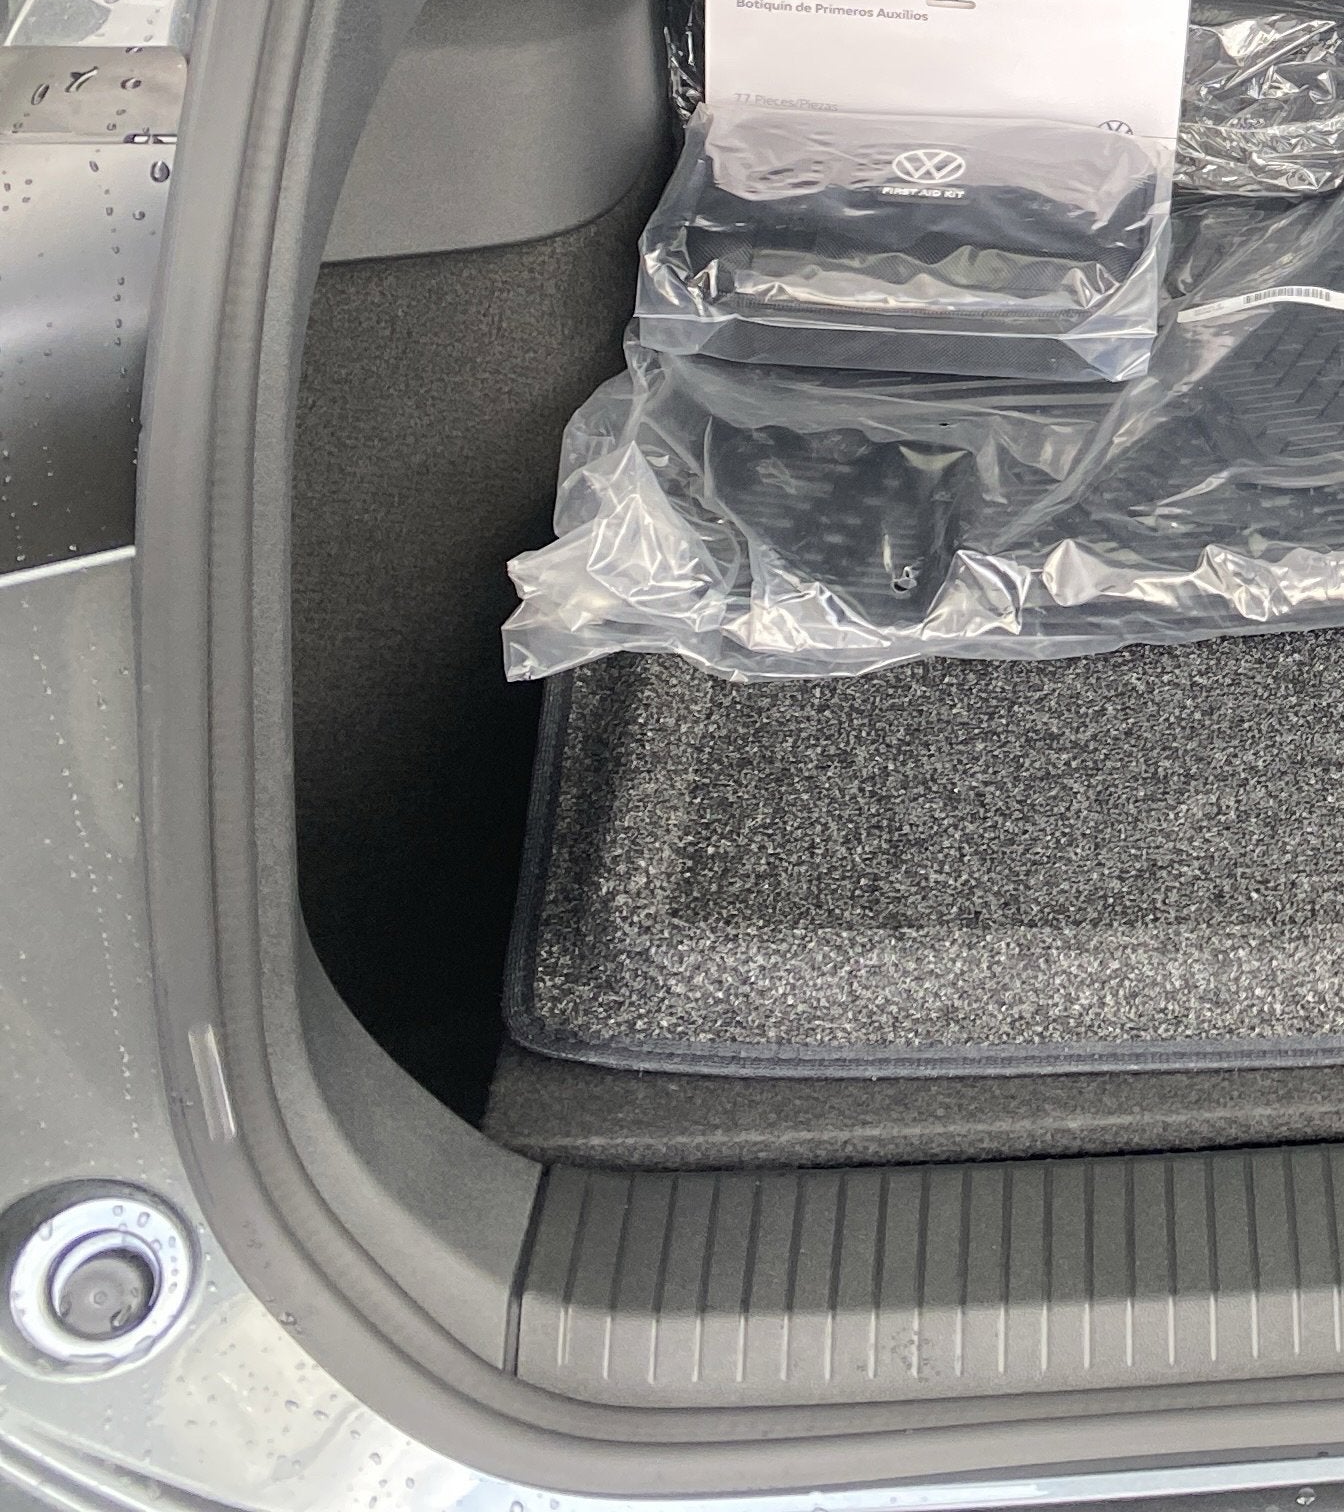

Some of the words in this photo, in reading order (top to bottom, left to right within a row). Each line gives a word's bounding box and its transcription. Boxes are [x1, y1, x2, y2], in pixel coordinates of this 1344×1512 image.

[795, 1, 812, 13] de
[815, 3, 874, 18] Primeros
[876, 7, 929, 22] Auxilios
[733, 92, 751, 104] 77
[754, 94, 839, 112] Pieces/Piezas
[881, 186, 918, 196] FIRST
[918, 188, 942, 198] AID
[943, 189, 966, 199] KIT
